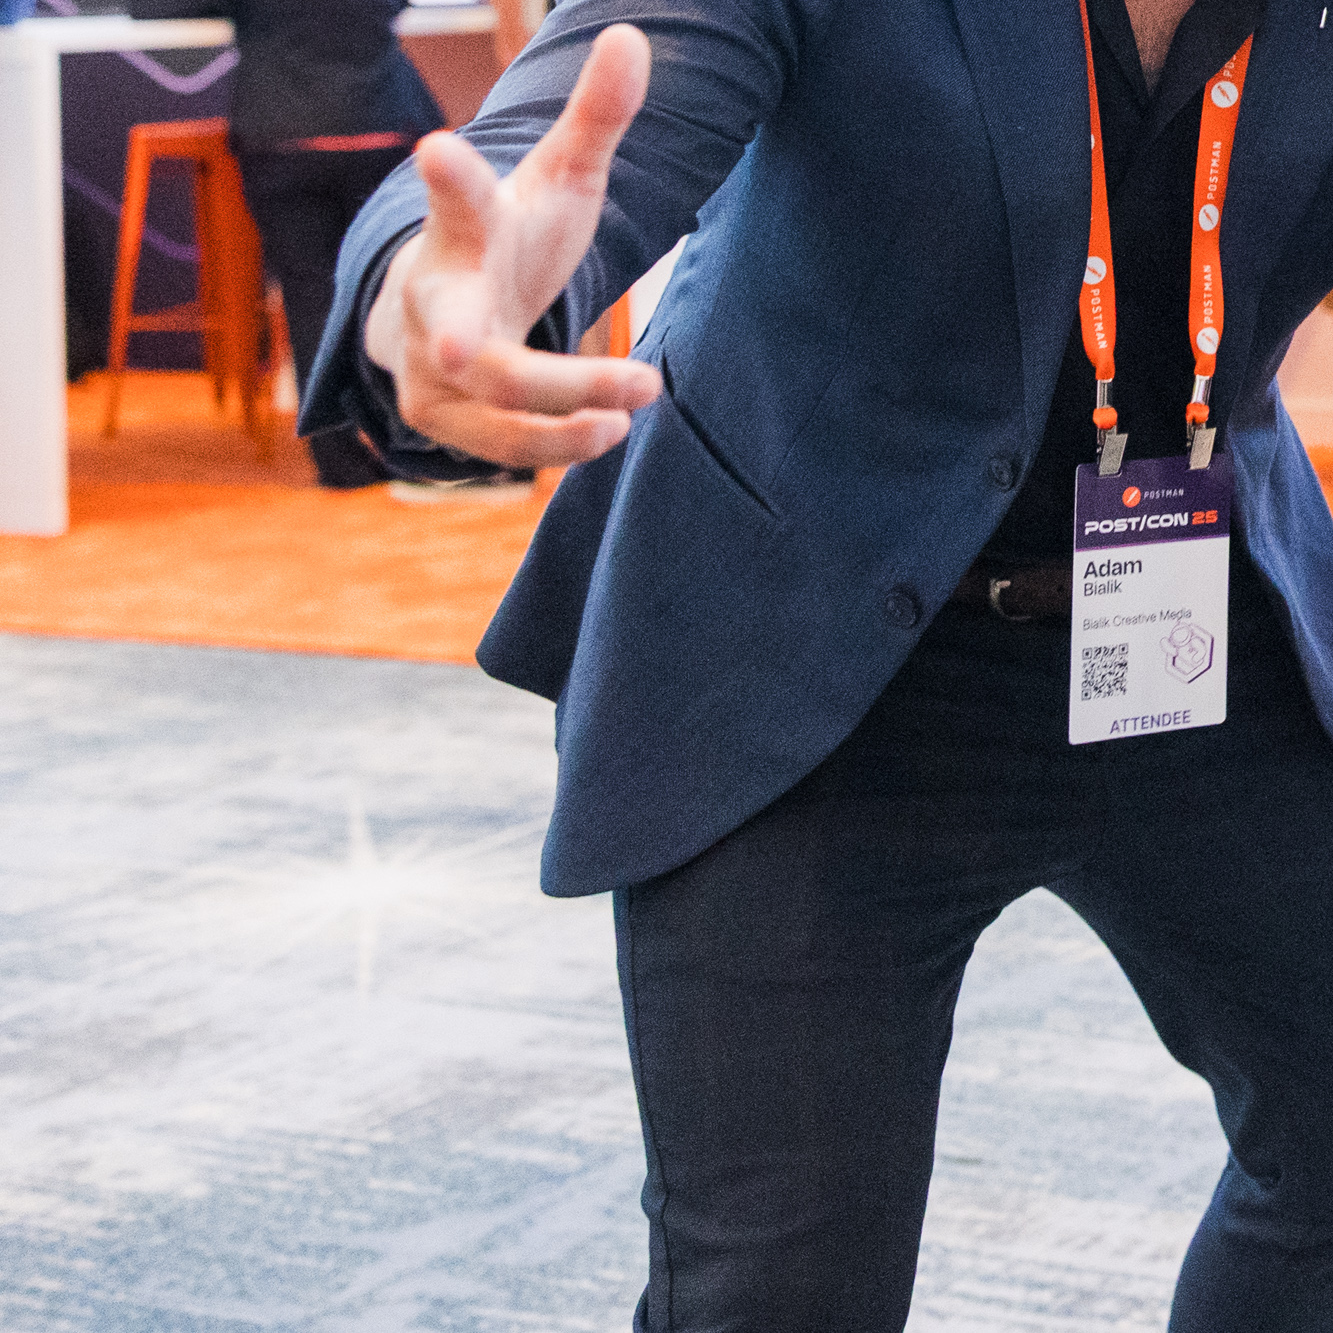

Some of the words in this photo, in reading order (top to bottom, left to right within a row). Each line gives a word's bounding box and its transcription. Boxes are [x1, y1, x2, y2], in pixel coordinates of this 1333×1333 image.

[1207, 141, 1222, 200] POSTMAN
[1203, 264, 1214, 325] POSTMAN
[1091, 288, 1108, 349] POSTMAN
[1143, 488, 1185, 499] POSTMAN
[1084, 512, 1189, 535] POST/CON
[1191, 510, 1218, 525] 25
[1083, 559, 1143, 579] Adam
[1083, 580, 1122, 597] Bialik
[1083, 617, 1110, 631] Bialik
[1112, 613, 1157, 628] Creative
[1159, 607, 1193, 621] Media
[1109, 709, 1192, 735] ATTENDEE
